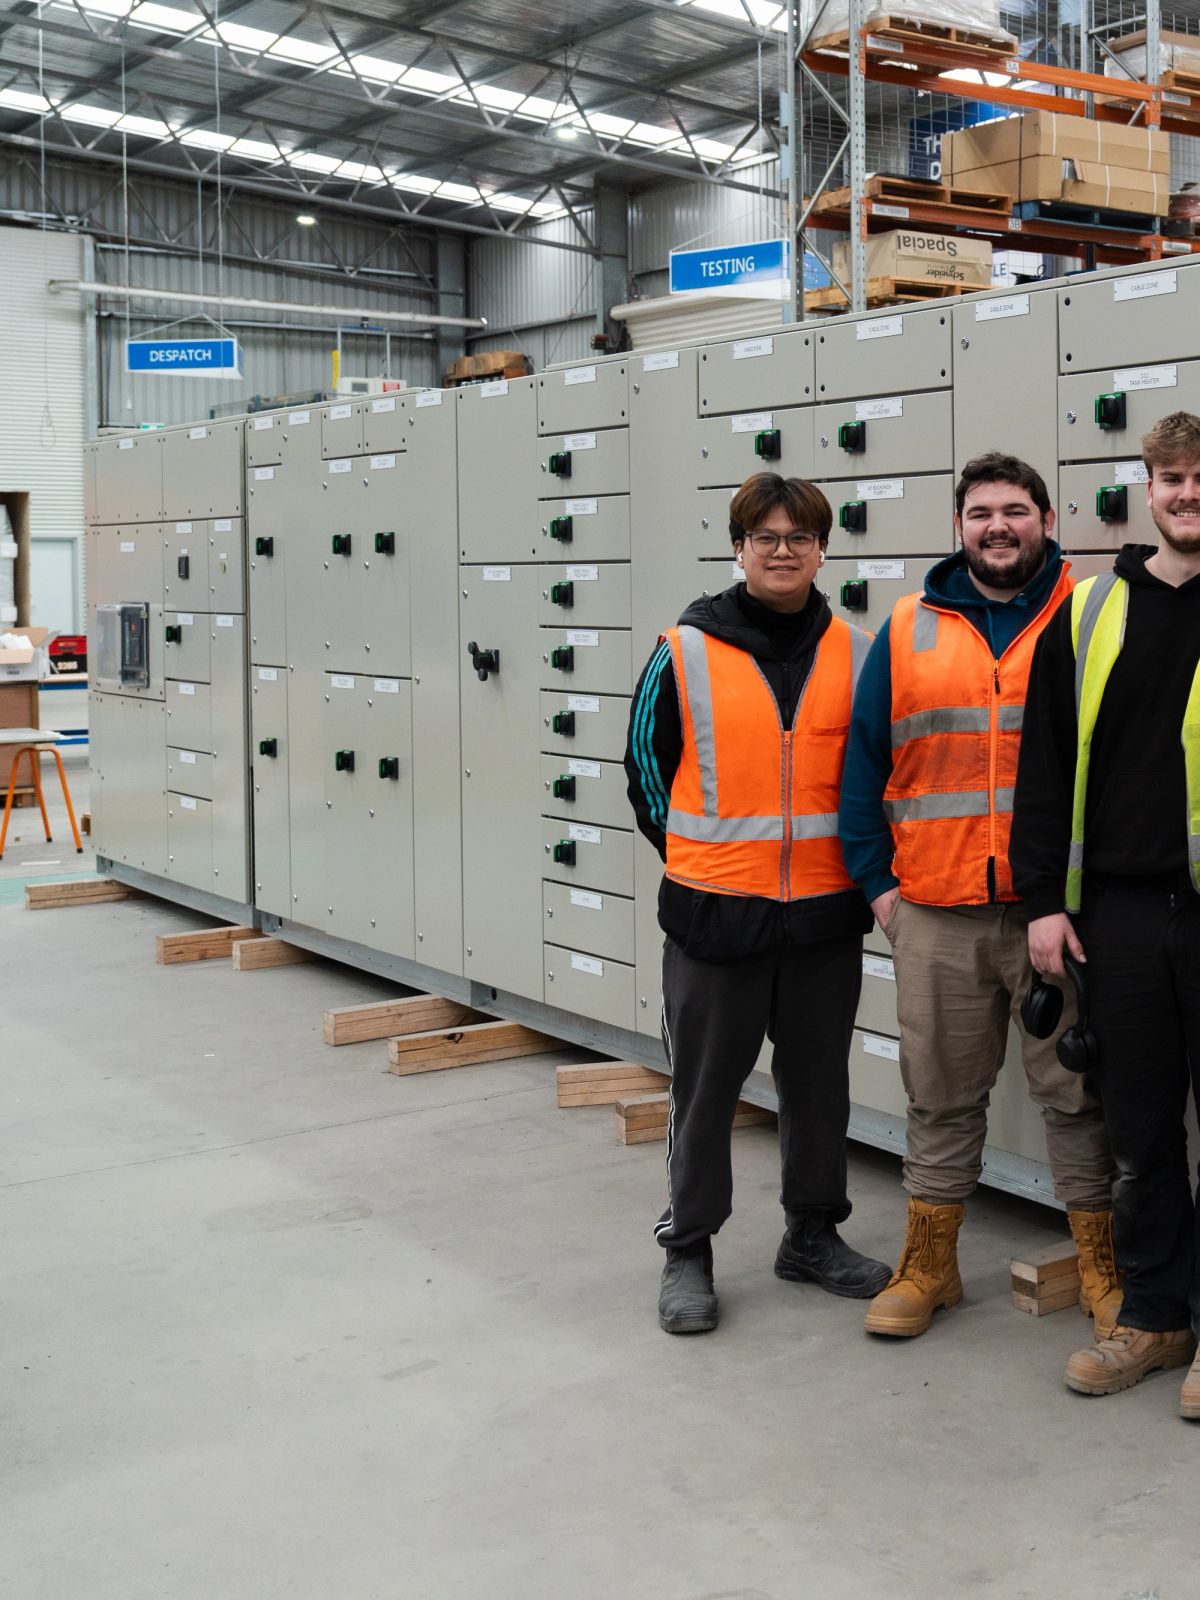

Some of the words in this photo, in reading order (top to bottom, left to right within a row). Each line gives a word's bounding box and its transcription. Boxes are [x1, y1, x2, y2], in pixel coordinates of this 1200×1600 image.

[1009, 219, 1020, 230] 3B
[897, 235, 958, 257] Spacial
[701, 256, 755, 277] TESTING
[926, 265, 965, 281] Schneider
[1131, 283, 1145, 291] CABLE
[1146, 281, 1158, 289] ZONE
[149, 349, 212, 362] DESPATCH
[1142, 377, 1159, 385] HEATER
